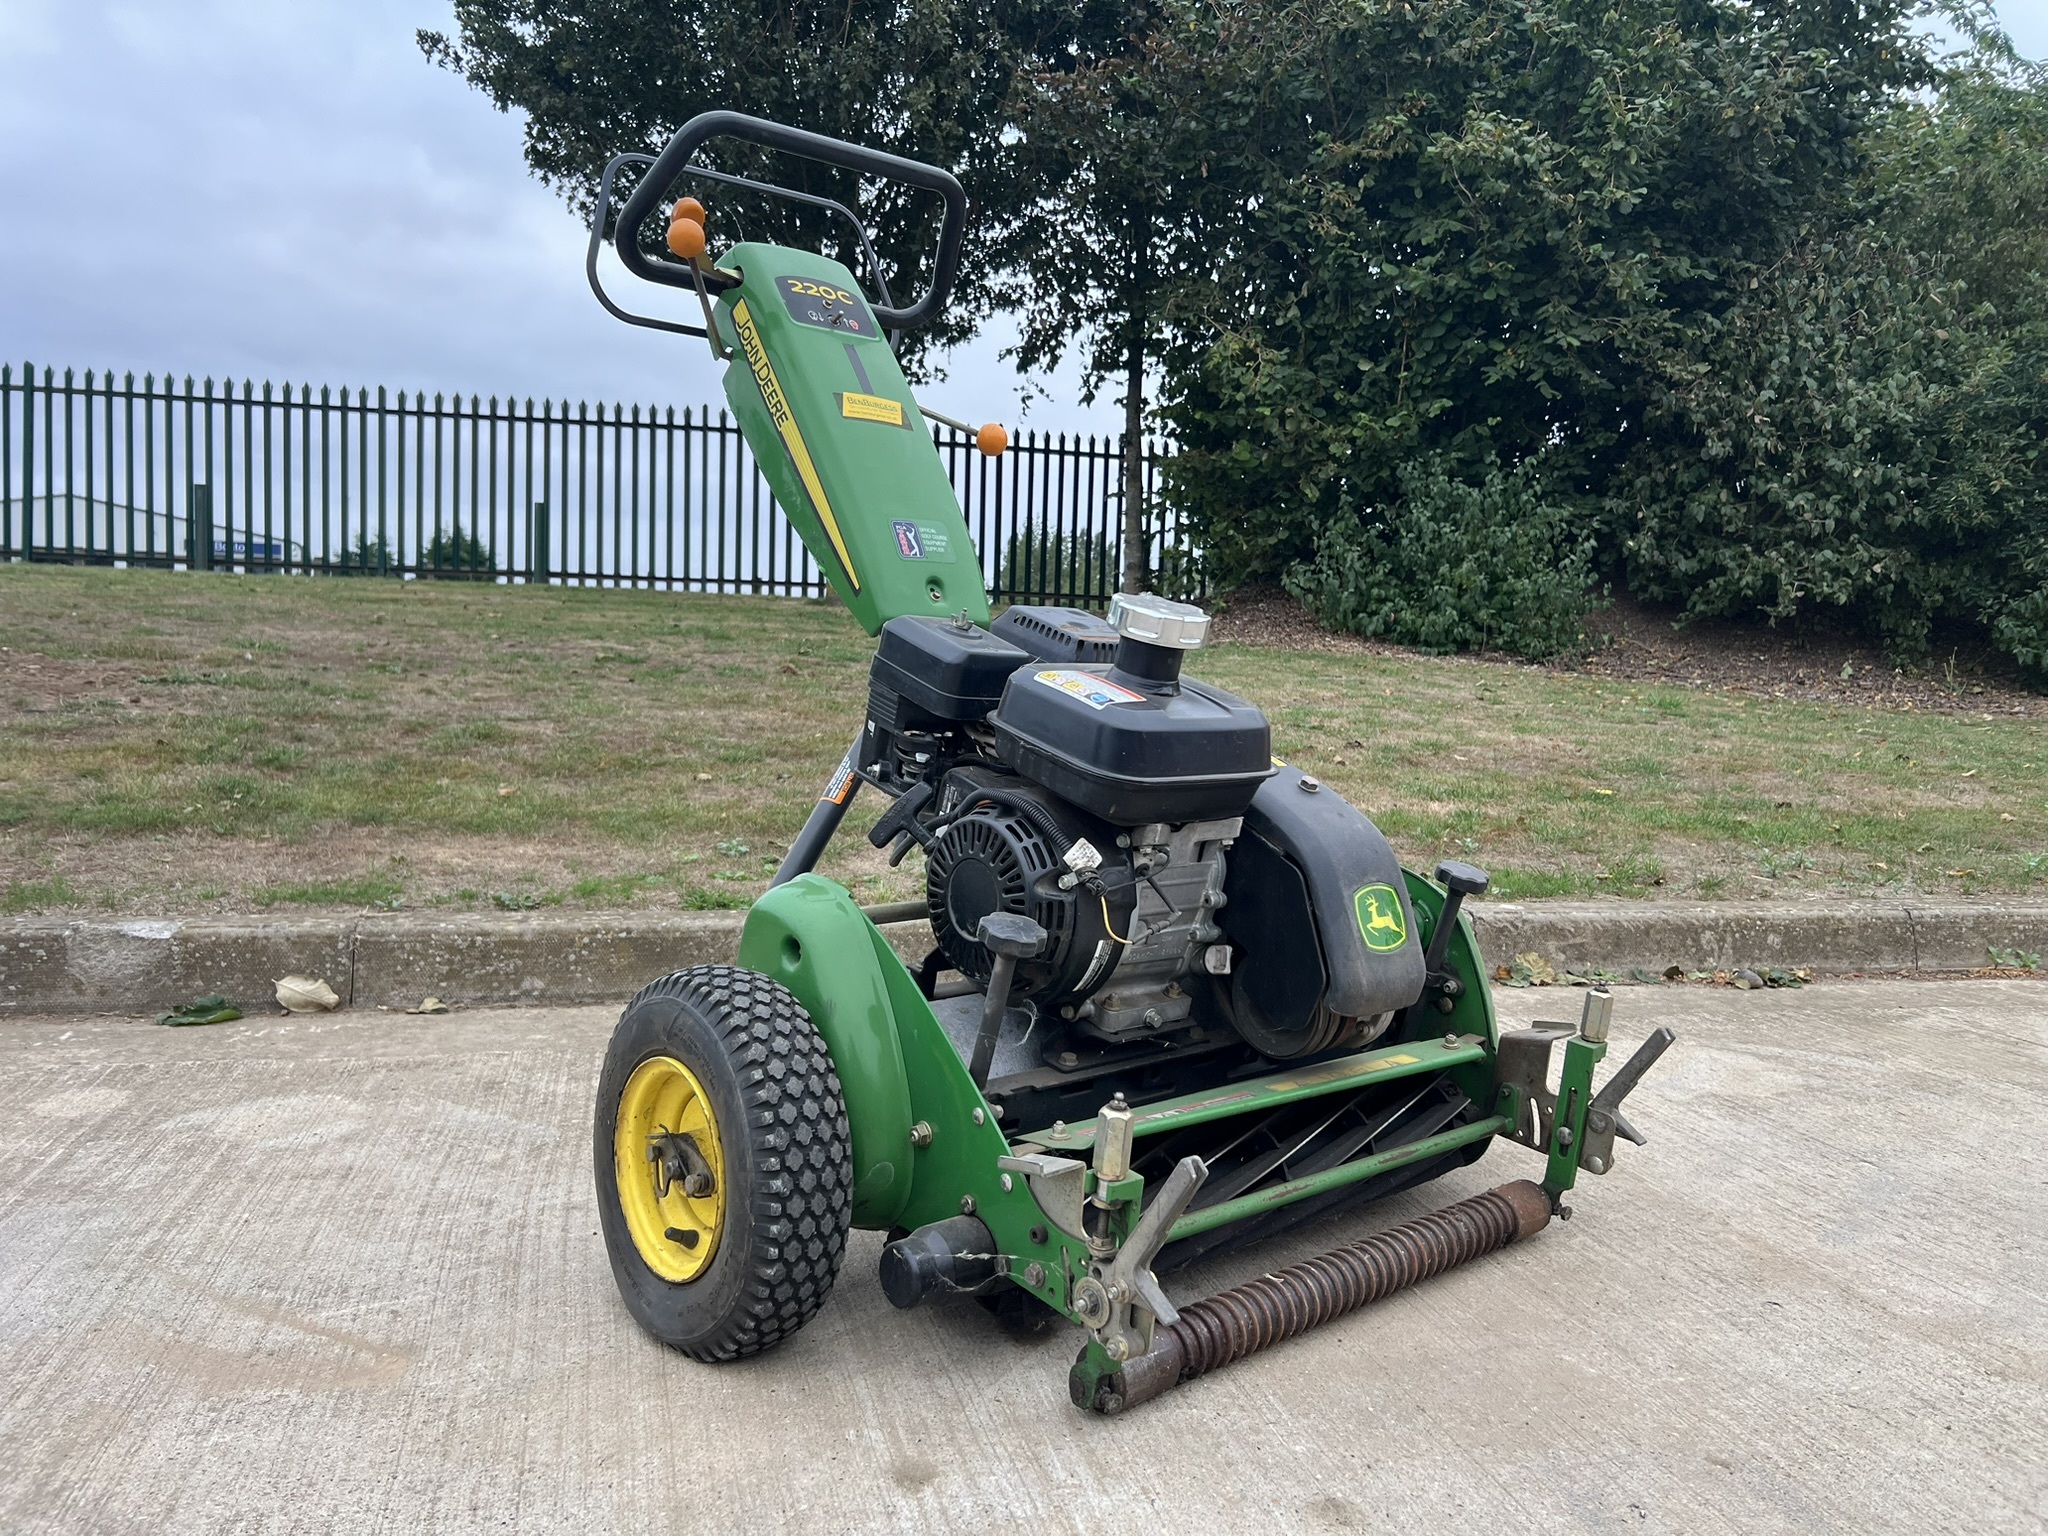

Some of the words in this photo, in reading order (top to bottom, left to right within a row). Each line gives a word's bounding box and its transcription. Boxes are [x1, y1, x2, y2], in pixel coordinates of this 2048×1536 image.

[787, 280, 854, 305] 220C
[736, 318, 763, 367] JOHN
[756, 361, 789, 429] DEERE
